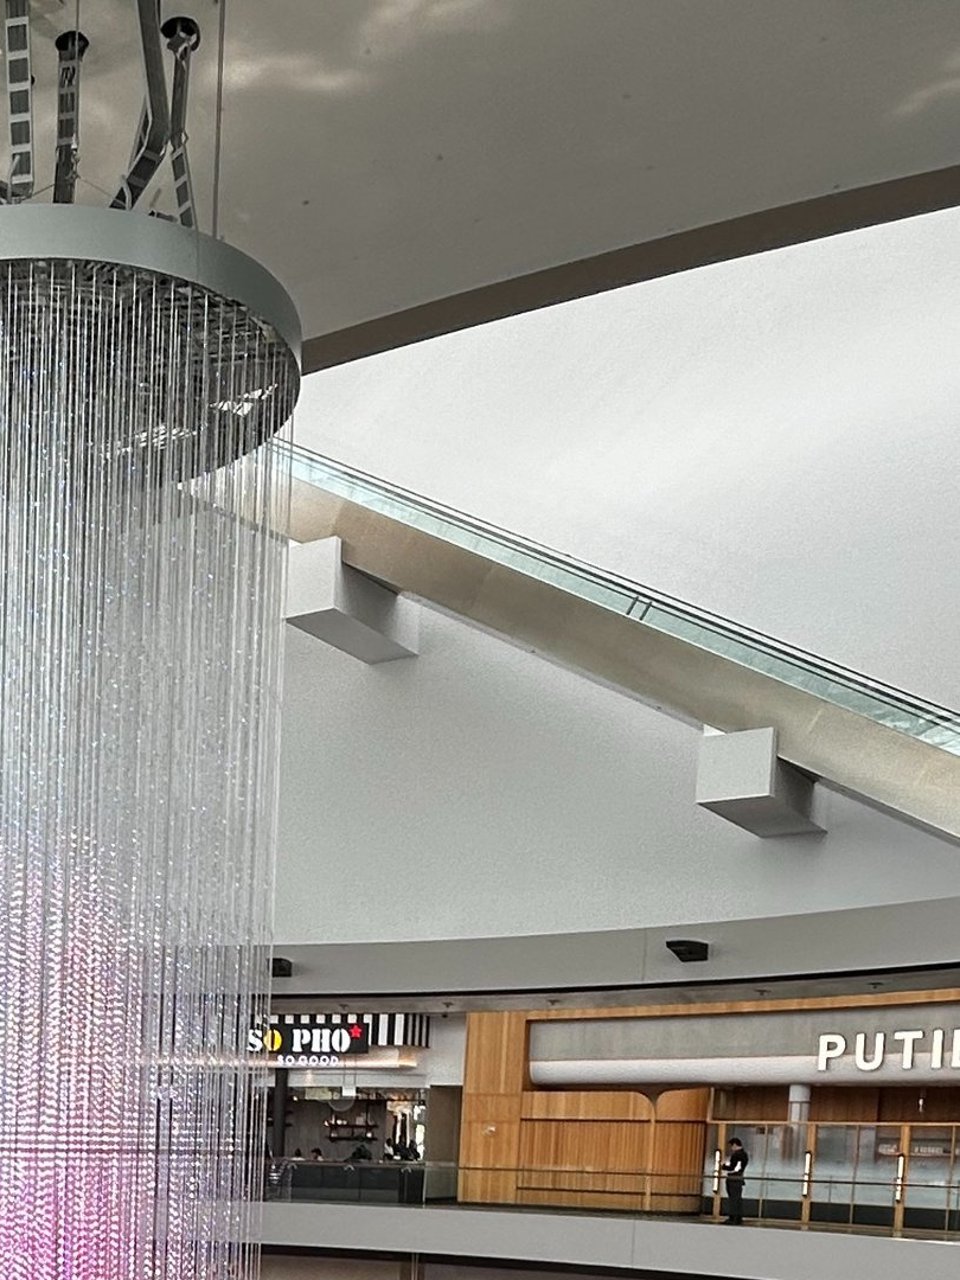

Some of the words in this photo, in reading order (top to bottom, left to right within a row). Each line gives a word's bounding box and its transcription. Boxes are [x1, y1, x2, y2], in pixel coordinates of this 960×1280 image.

[247, 1028, 282, 1052] SO
[292, 1028, 351, 1053] PHO
[298, 1055, 339, 1067] GOOD
